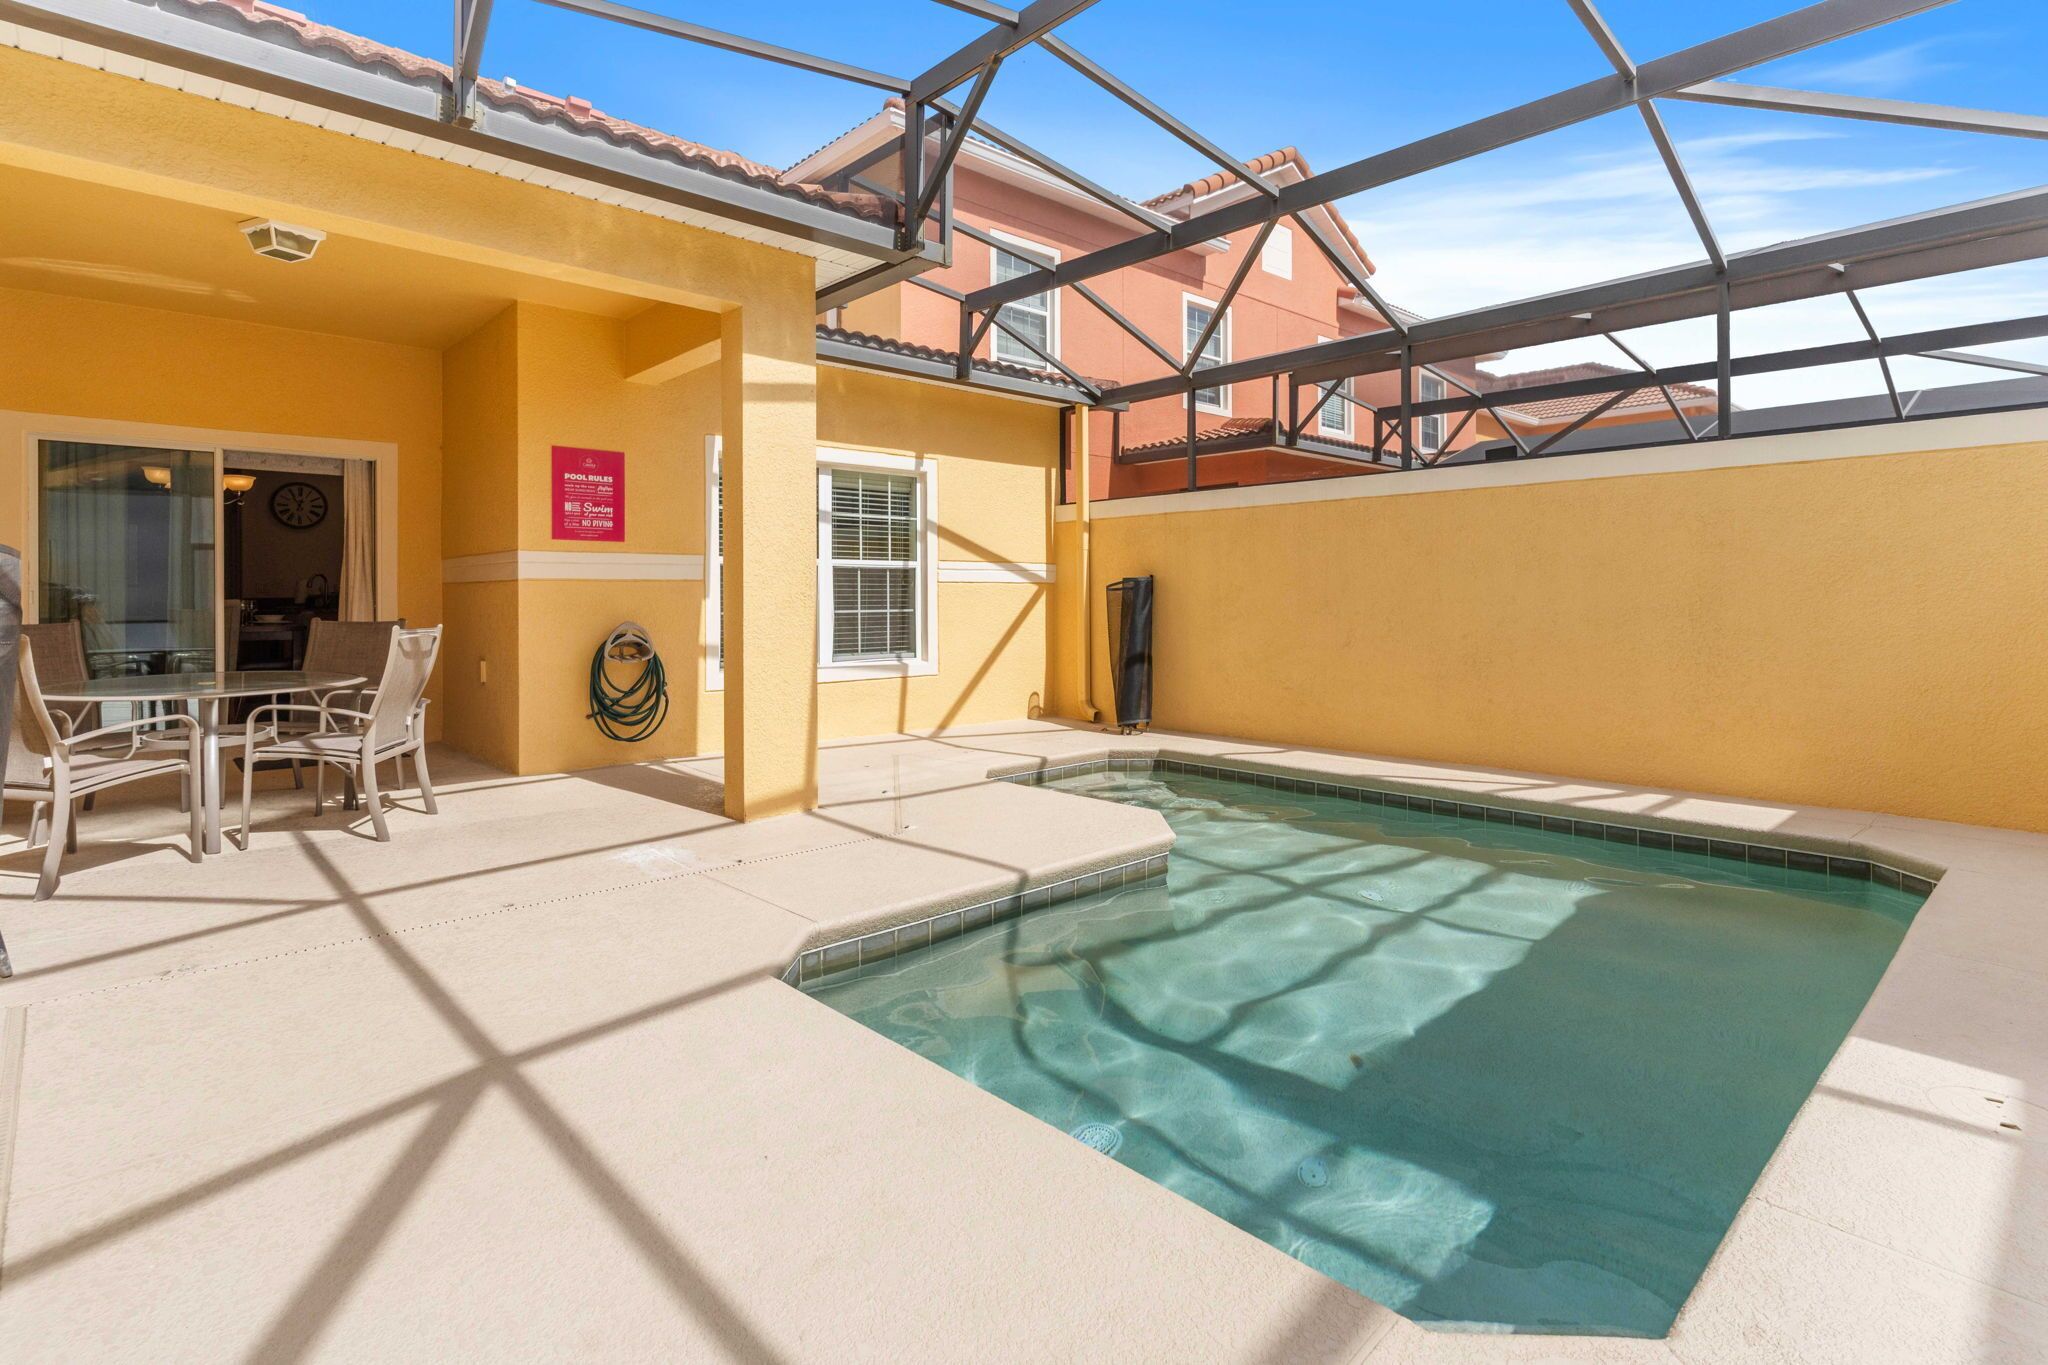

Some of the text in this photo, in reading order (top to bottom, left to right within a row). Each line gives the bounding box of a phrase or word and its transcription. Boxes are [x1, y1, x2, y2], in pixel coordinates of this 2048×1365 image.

[564, 473, 587, 481] POOL
[583, 502, 613, 513] Swim
[581, 519, 592, 527] NO
[592, 520, 613, 528] DIVING
